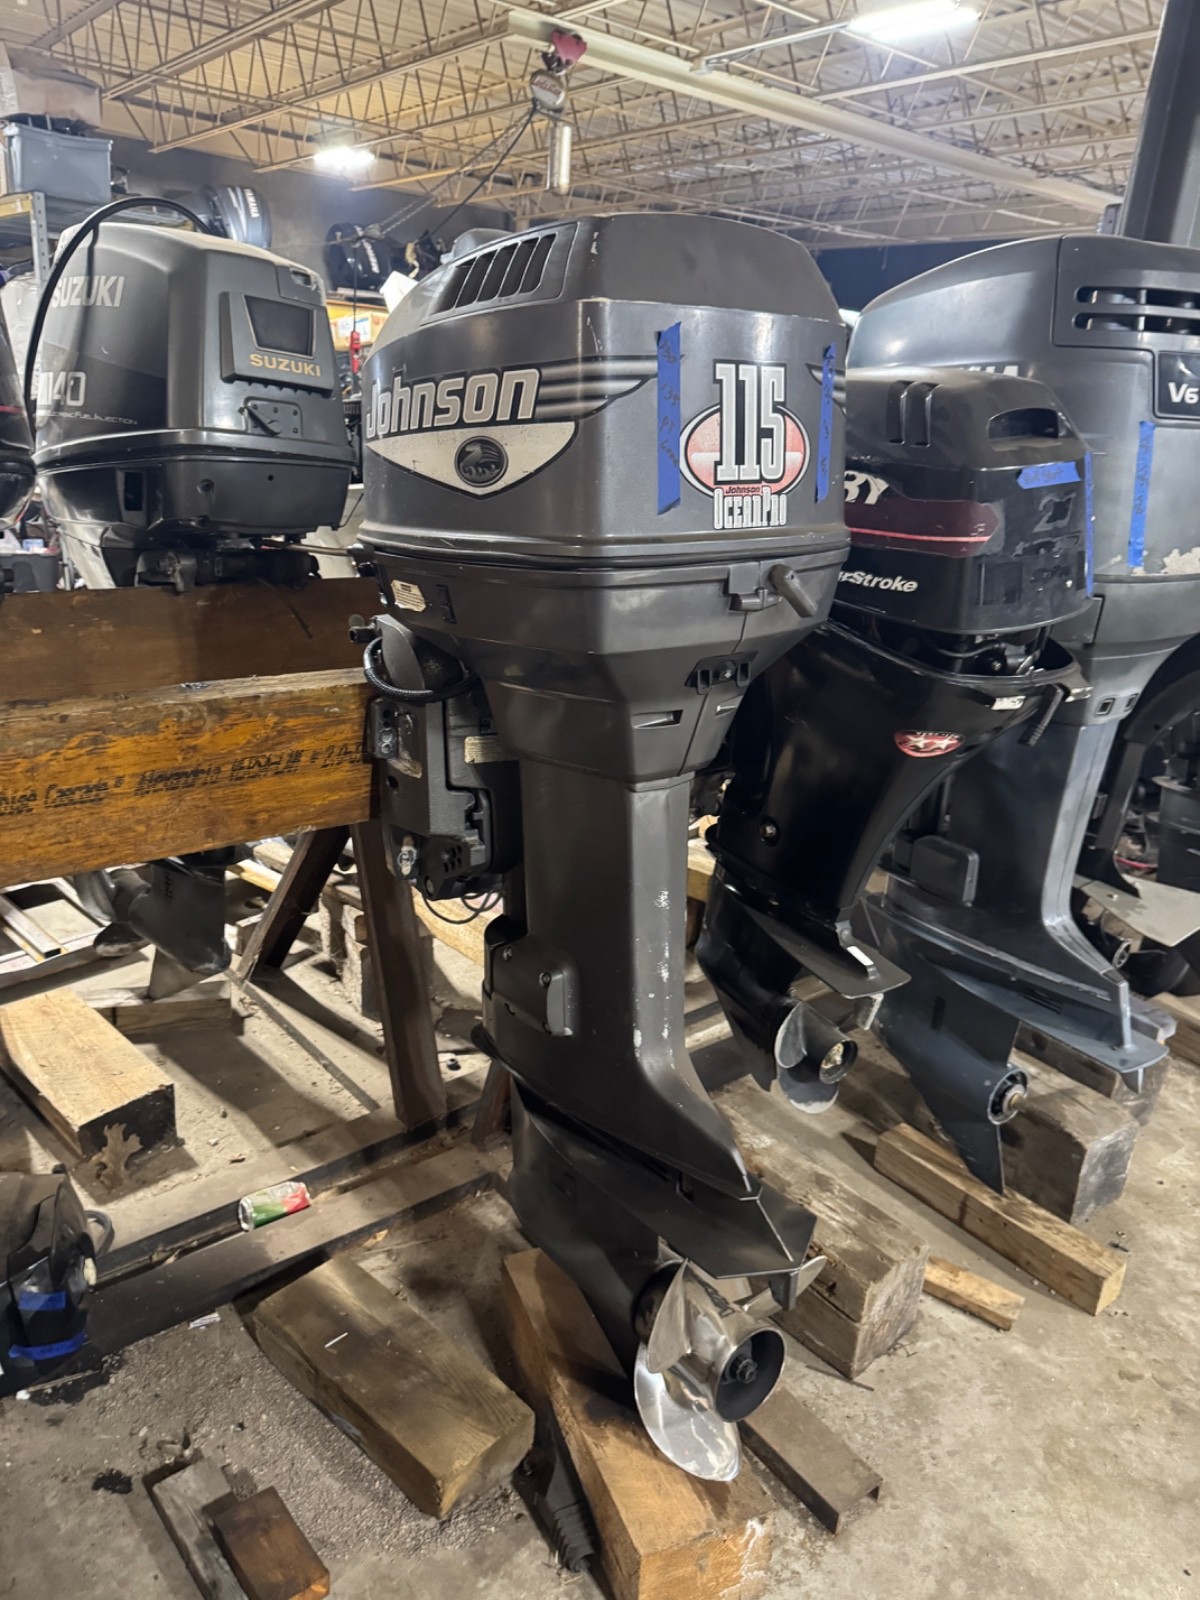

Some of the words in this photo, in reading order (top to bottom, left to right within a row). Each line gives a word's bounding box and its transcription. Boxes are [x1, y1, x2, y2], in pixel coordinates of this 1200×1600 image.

[51, 275, 125, 309] SUZUKI
[249, 353, 321, 377] SUZUKI
[366, 368, 540, 440] Johnson
[1168, 381, 1199, 404] V6
[714, 361, 787, 483] 115
[725, 485, 761, 495] Johnson
